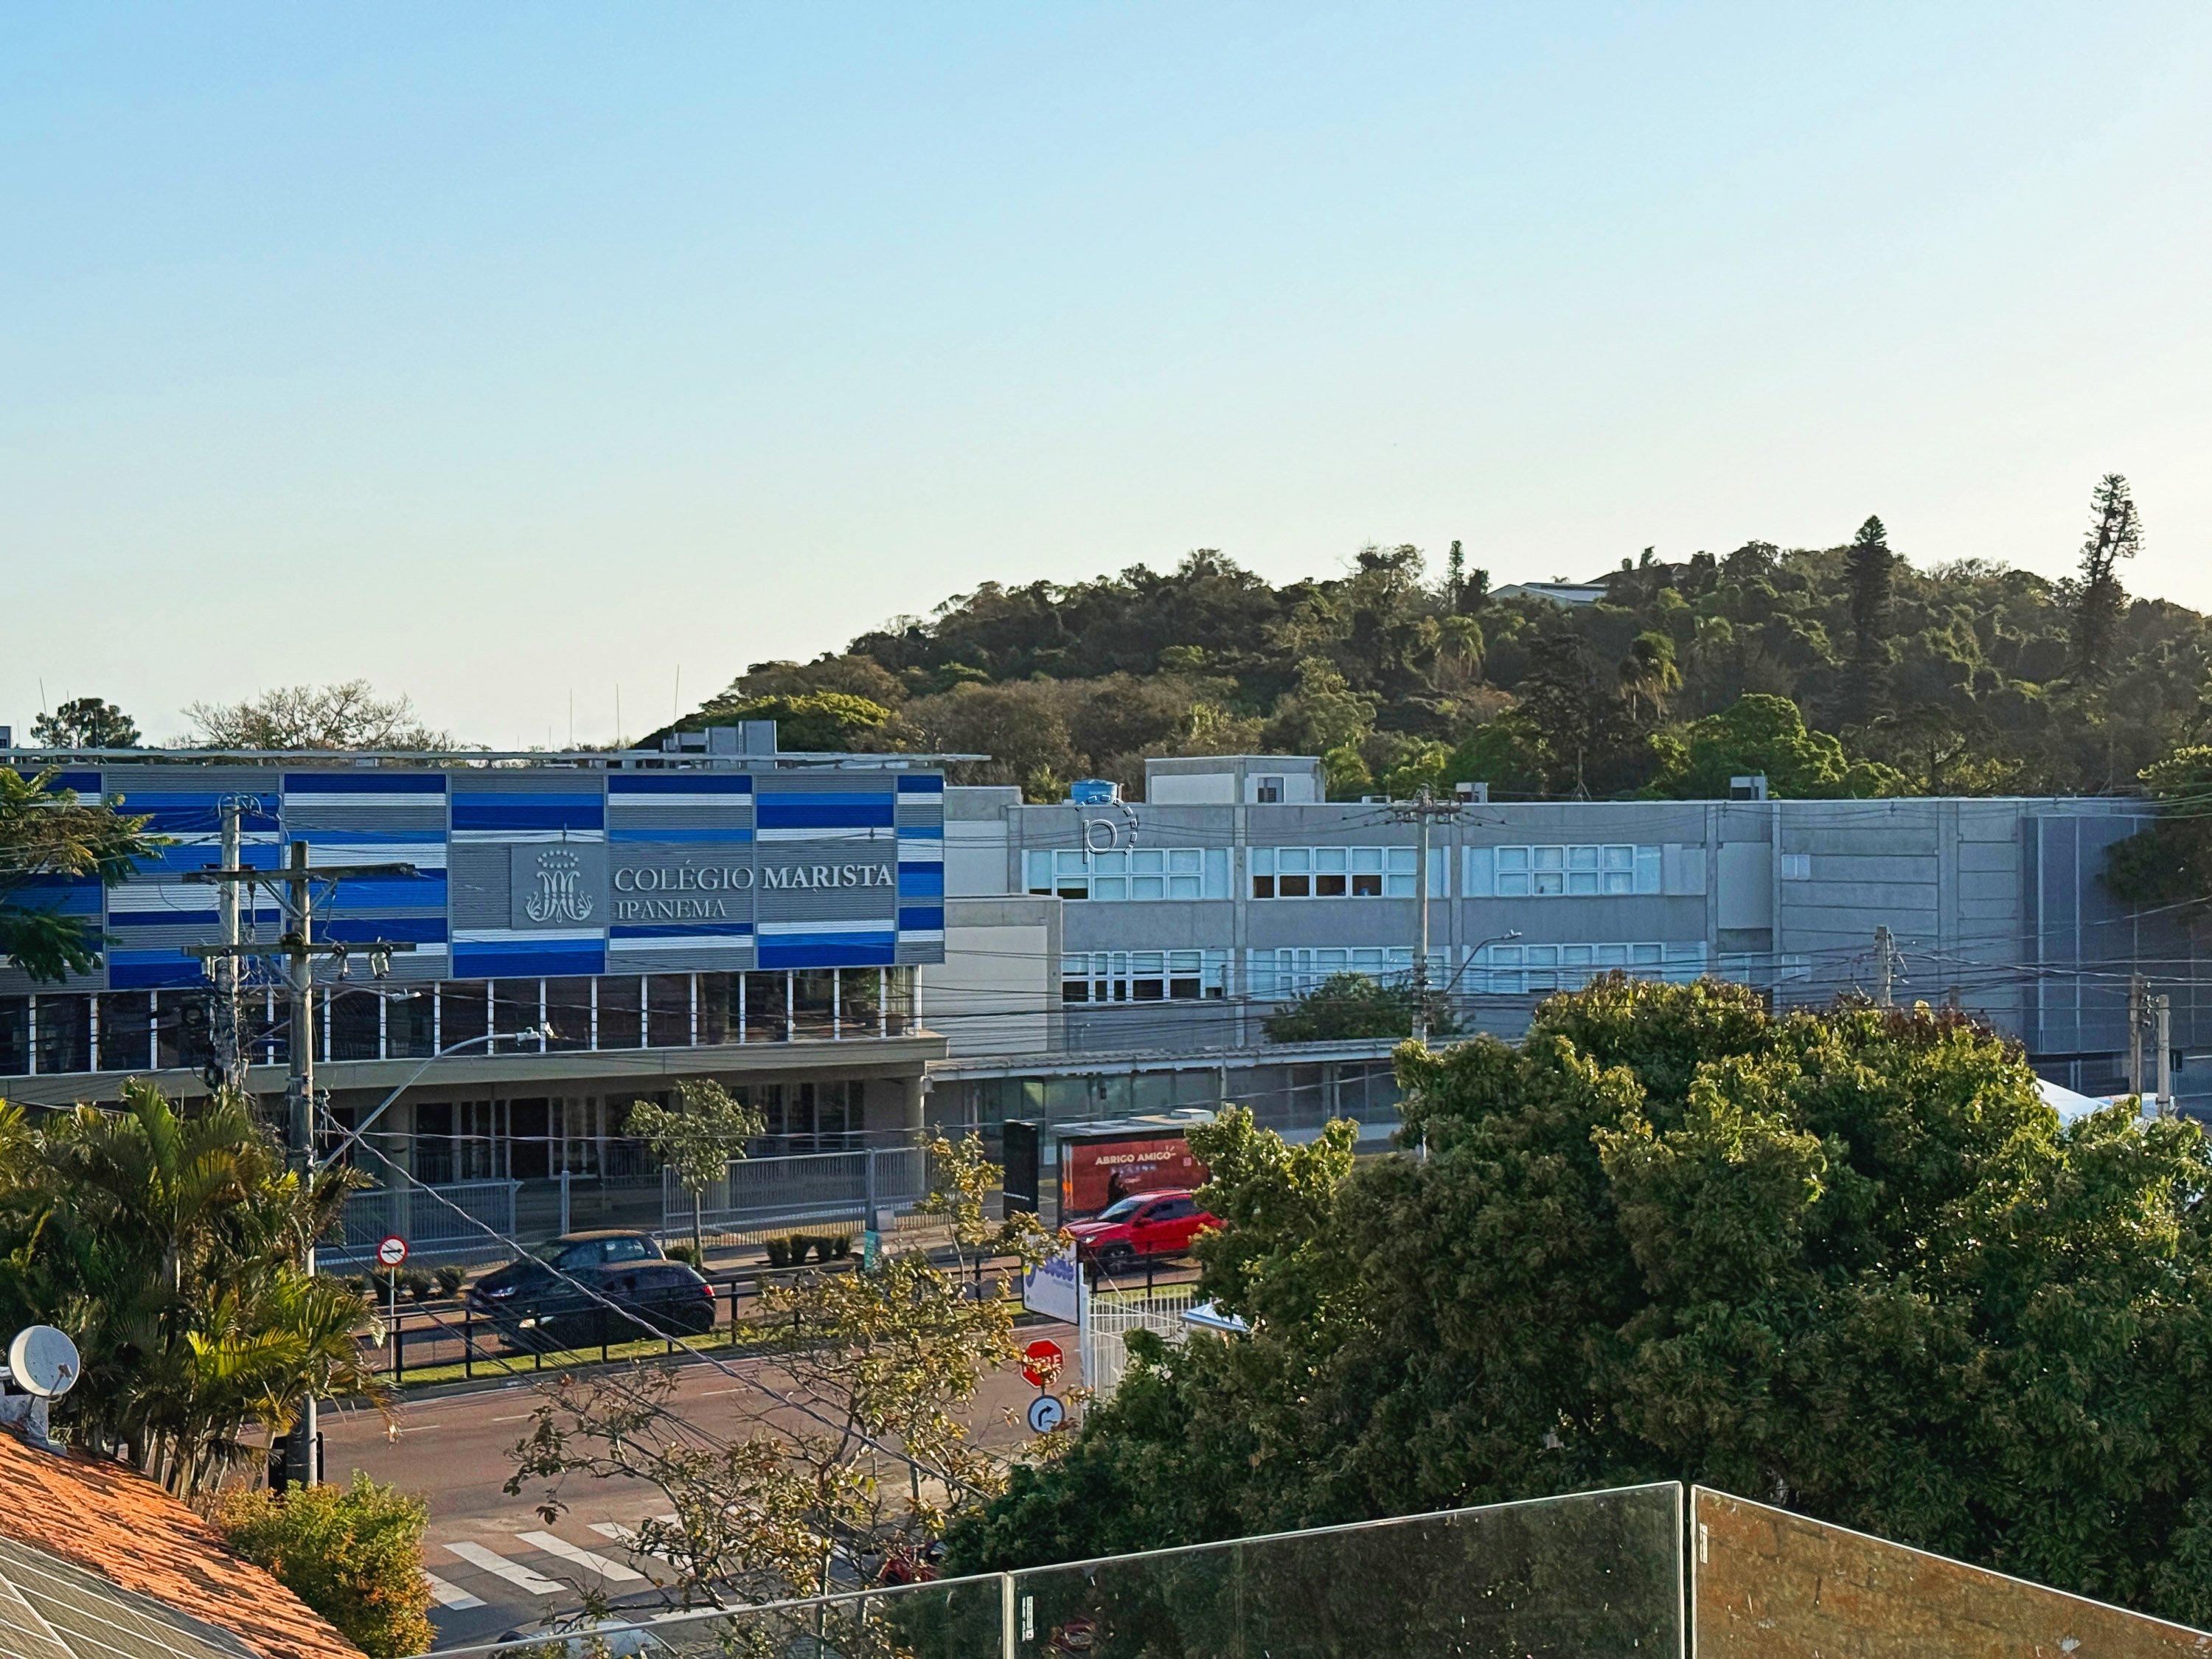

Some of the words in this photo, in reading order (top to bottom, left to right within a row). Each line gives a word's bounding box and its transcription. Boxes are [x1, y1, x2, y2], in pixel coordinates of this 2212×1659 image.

[614, 859, 754, 892] COLÉGIO
[762, 864, 894, 890] MARISTA
[615, 898, 728, 920] IPANEMA
[1095, 1154, 1135, 1166] ABRIGO
